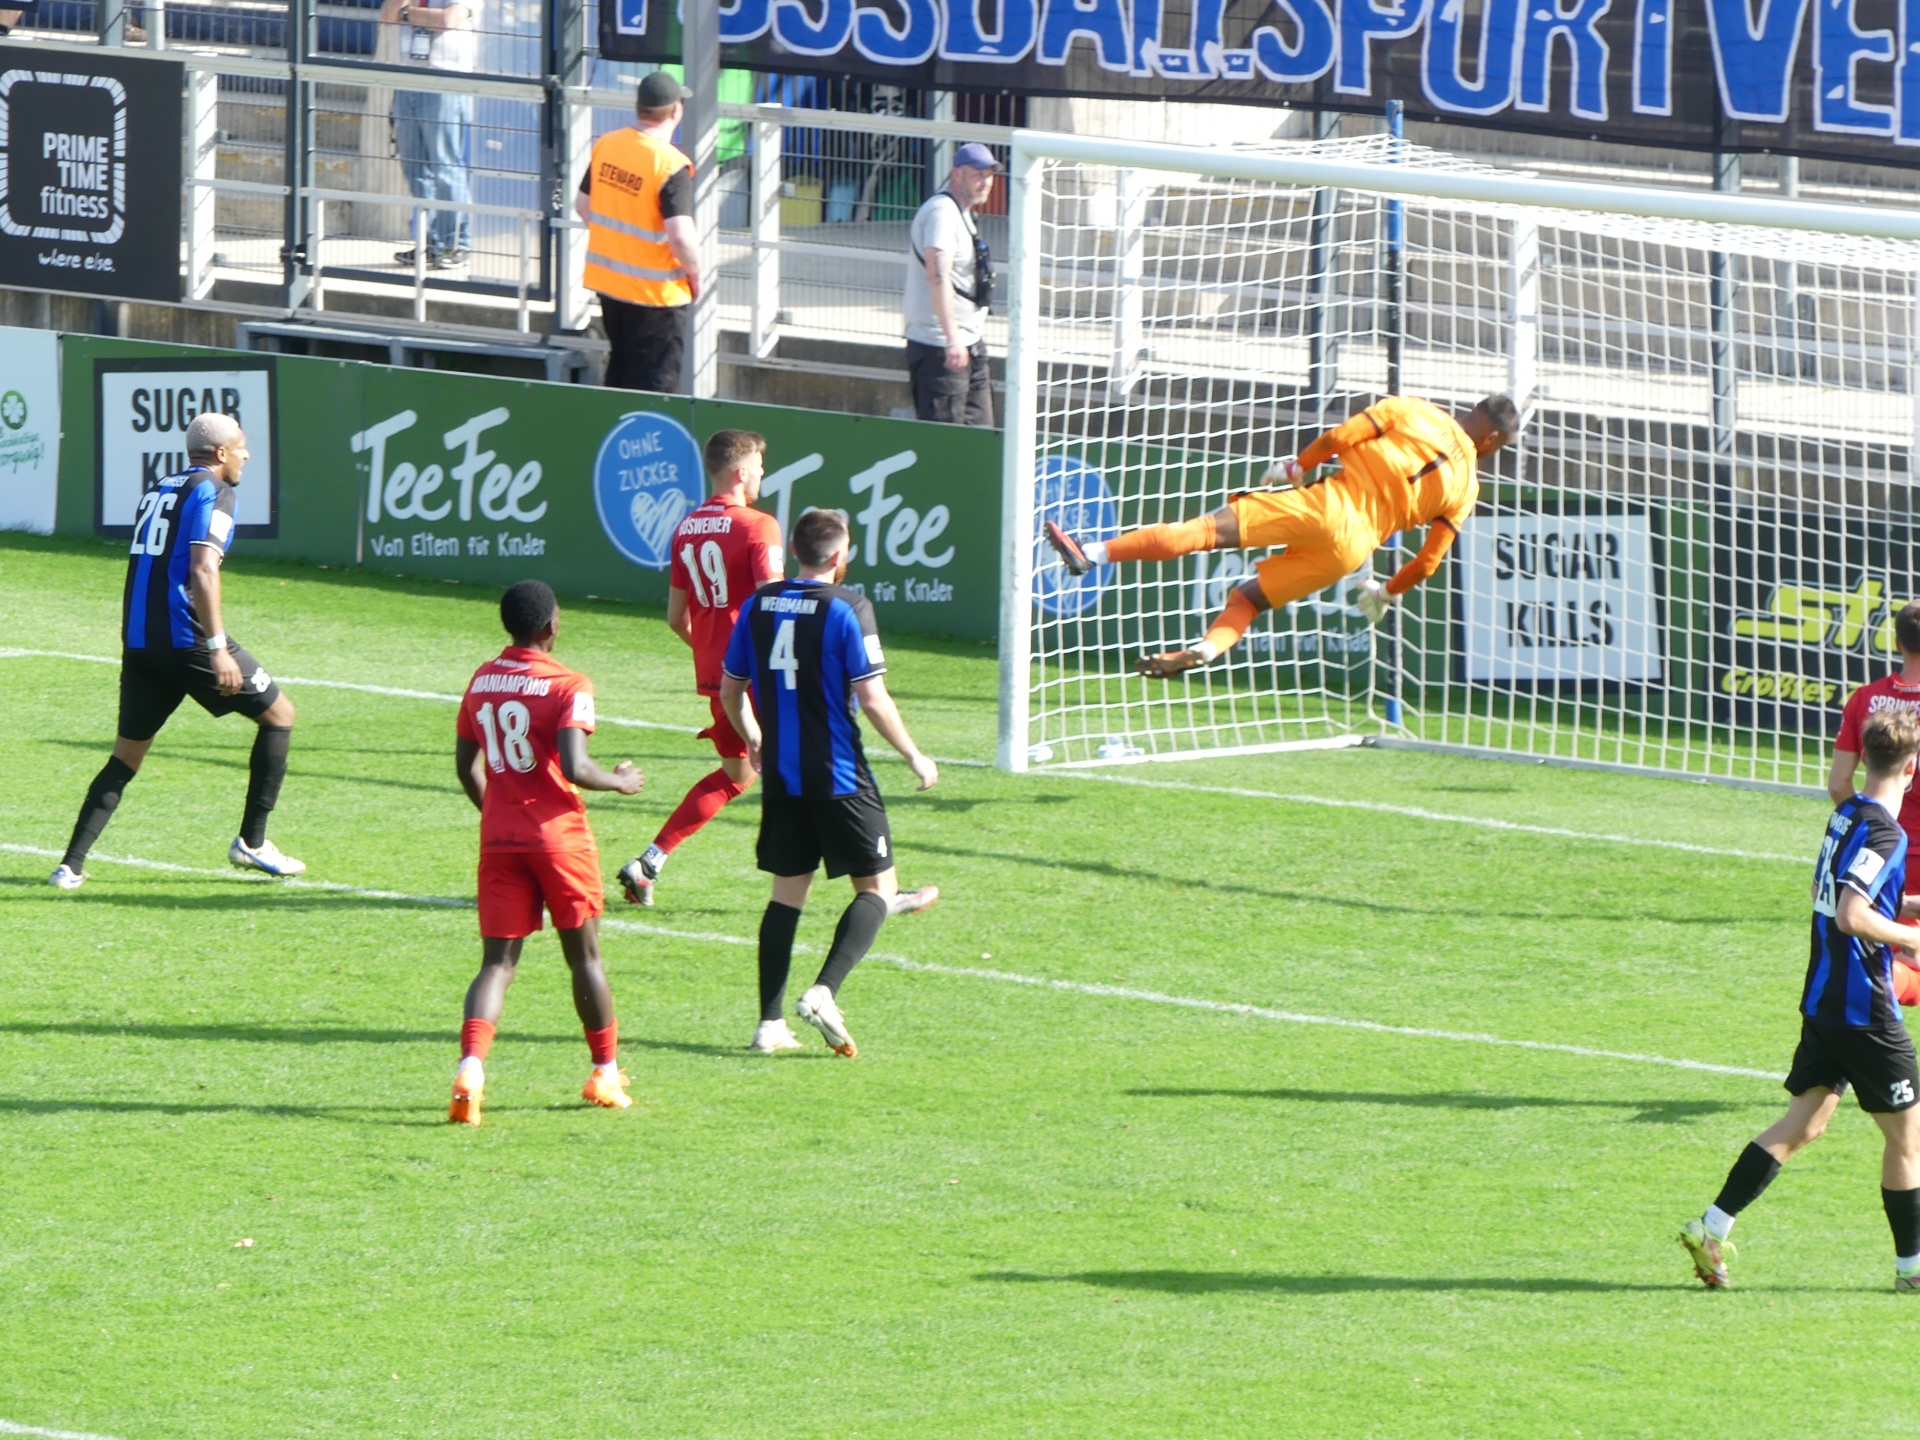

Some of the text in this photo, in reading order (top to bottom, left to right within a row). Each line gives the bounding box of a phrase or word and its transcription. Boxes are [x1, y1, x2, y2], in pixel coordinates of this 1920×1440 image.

[43, 132, 109, 163] PRIME
[57, 160, 109, 191] TIME
[599, 162, 644, 191] STEWARD
[40, 185, 109, 219] fitness
[38, 248, 116, 273] where else.
[618, 431, 663, 460] OHNE
[351, 406, 548, 523] TeeFee
[618, 461, 679, 491] ZUCKER
[130, 492, 178, 556] 26
[760, 450, 955, 568] TFee
[371, 532, 546, 556] Von Eltern für Kinder
[1495, 533, 1621, 580] SUGAR
[680, 541, 729, 608] 19
[874, 581, 897, 601] für
[905, 577, 954, 602] Kinder
[1507, 600, 1614, 648] KILLS
[769, 619, 799, 690] 4
[1720, 668, 1838, 704] Größtes
[475, 700, 538, 774] 18
[1890, 1079, 1914, 1105] 25
